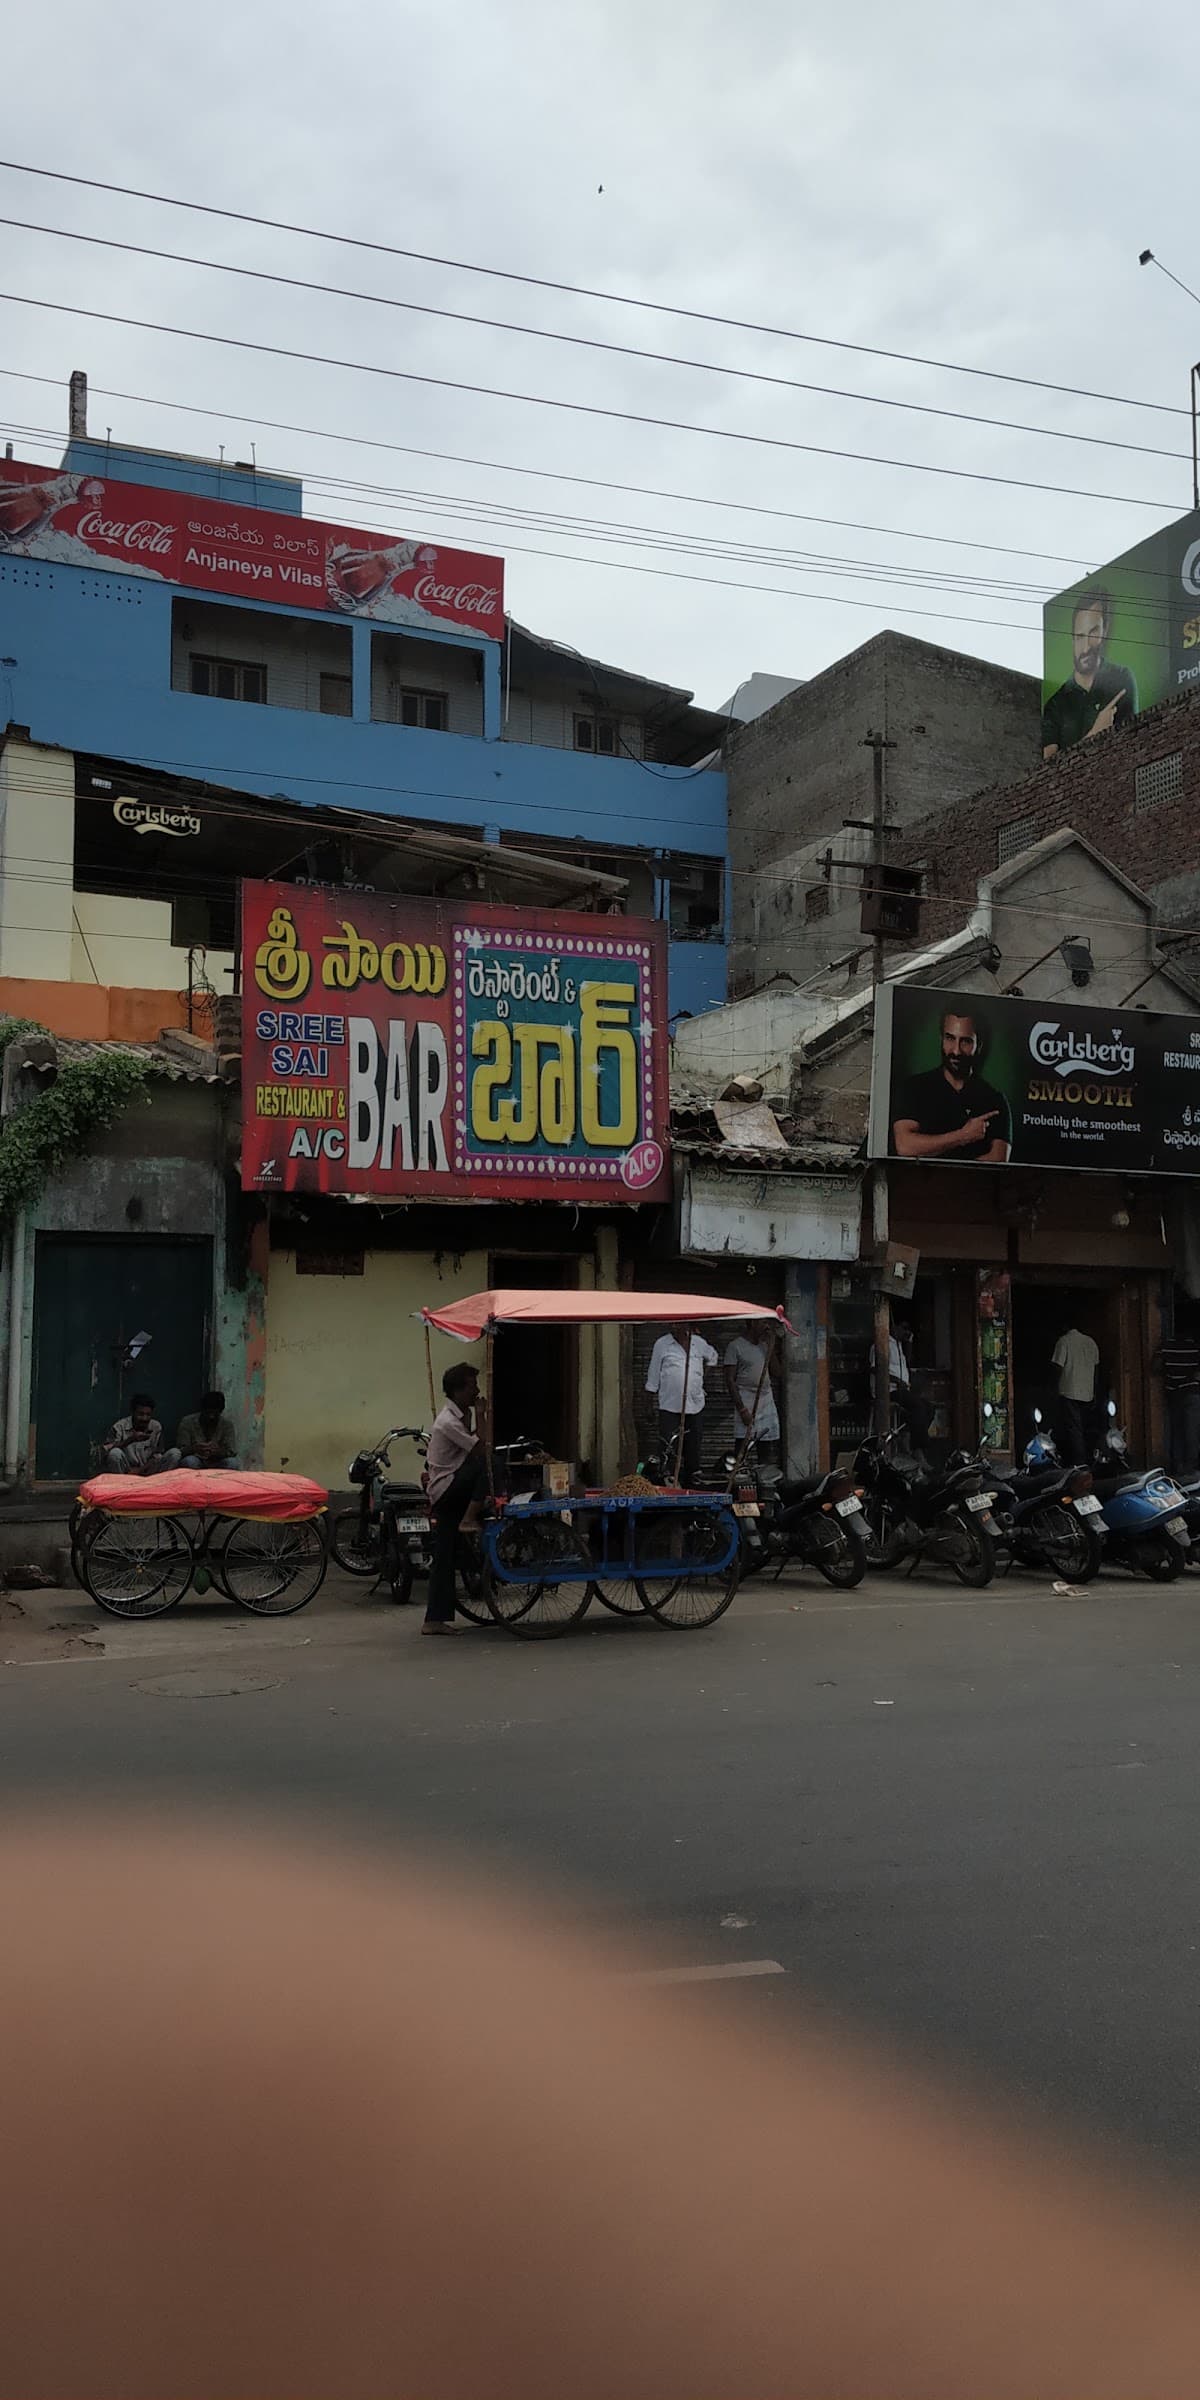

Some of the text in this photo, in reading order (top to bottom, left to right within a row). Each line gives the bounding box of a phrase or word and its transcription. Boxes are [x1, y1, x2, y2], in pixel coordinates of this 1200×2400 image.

[184, 546, 323, 588] Anjaneya Vilas
[113, 796, 201, 837] Carlsberg
[255, 907, 446, 1000] శ్రీ సాయి
[564, 979, 576, 1003] &
[256, 1011, 345, 1044] SREE
[272, 1046, 329, 1077] SAI
[471, 981, 637, 1146] బార్
[1029, 1021, 1135, 1077] Carlsberg
[256, 1085, 346, 1119] RESTAURANT &
[347, 1016, 450, 1171] BAR
[1027, 1080, 1134, 1107] SMOOTH
[1023, 1113, 1141, 1133] Probably the smoothest
[1070, 1131, 1081, 1139] the
[1083, 1133, 1104, 1141] world
[289, 1127, 345, 1159] A/C
[629, 1148, 656, 1180] A/C
